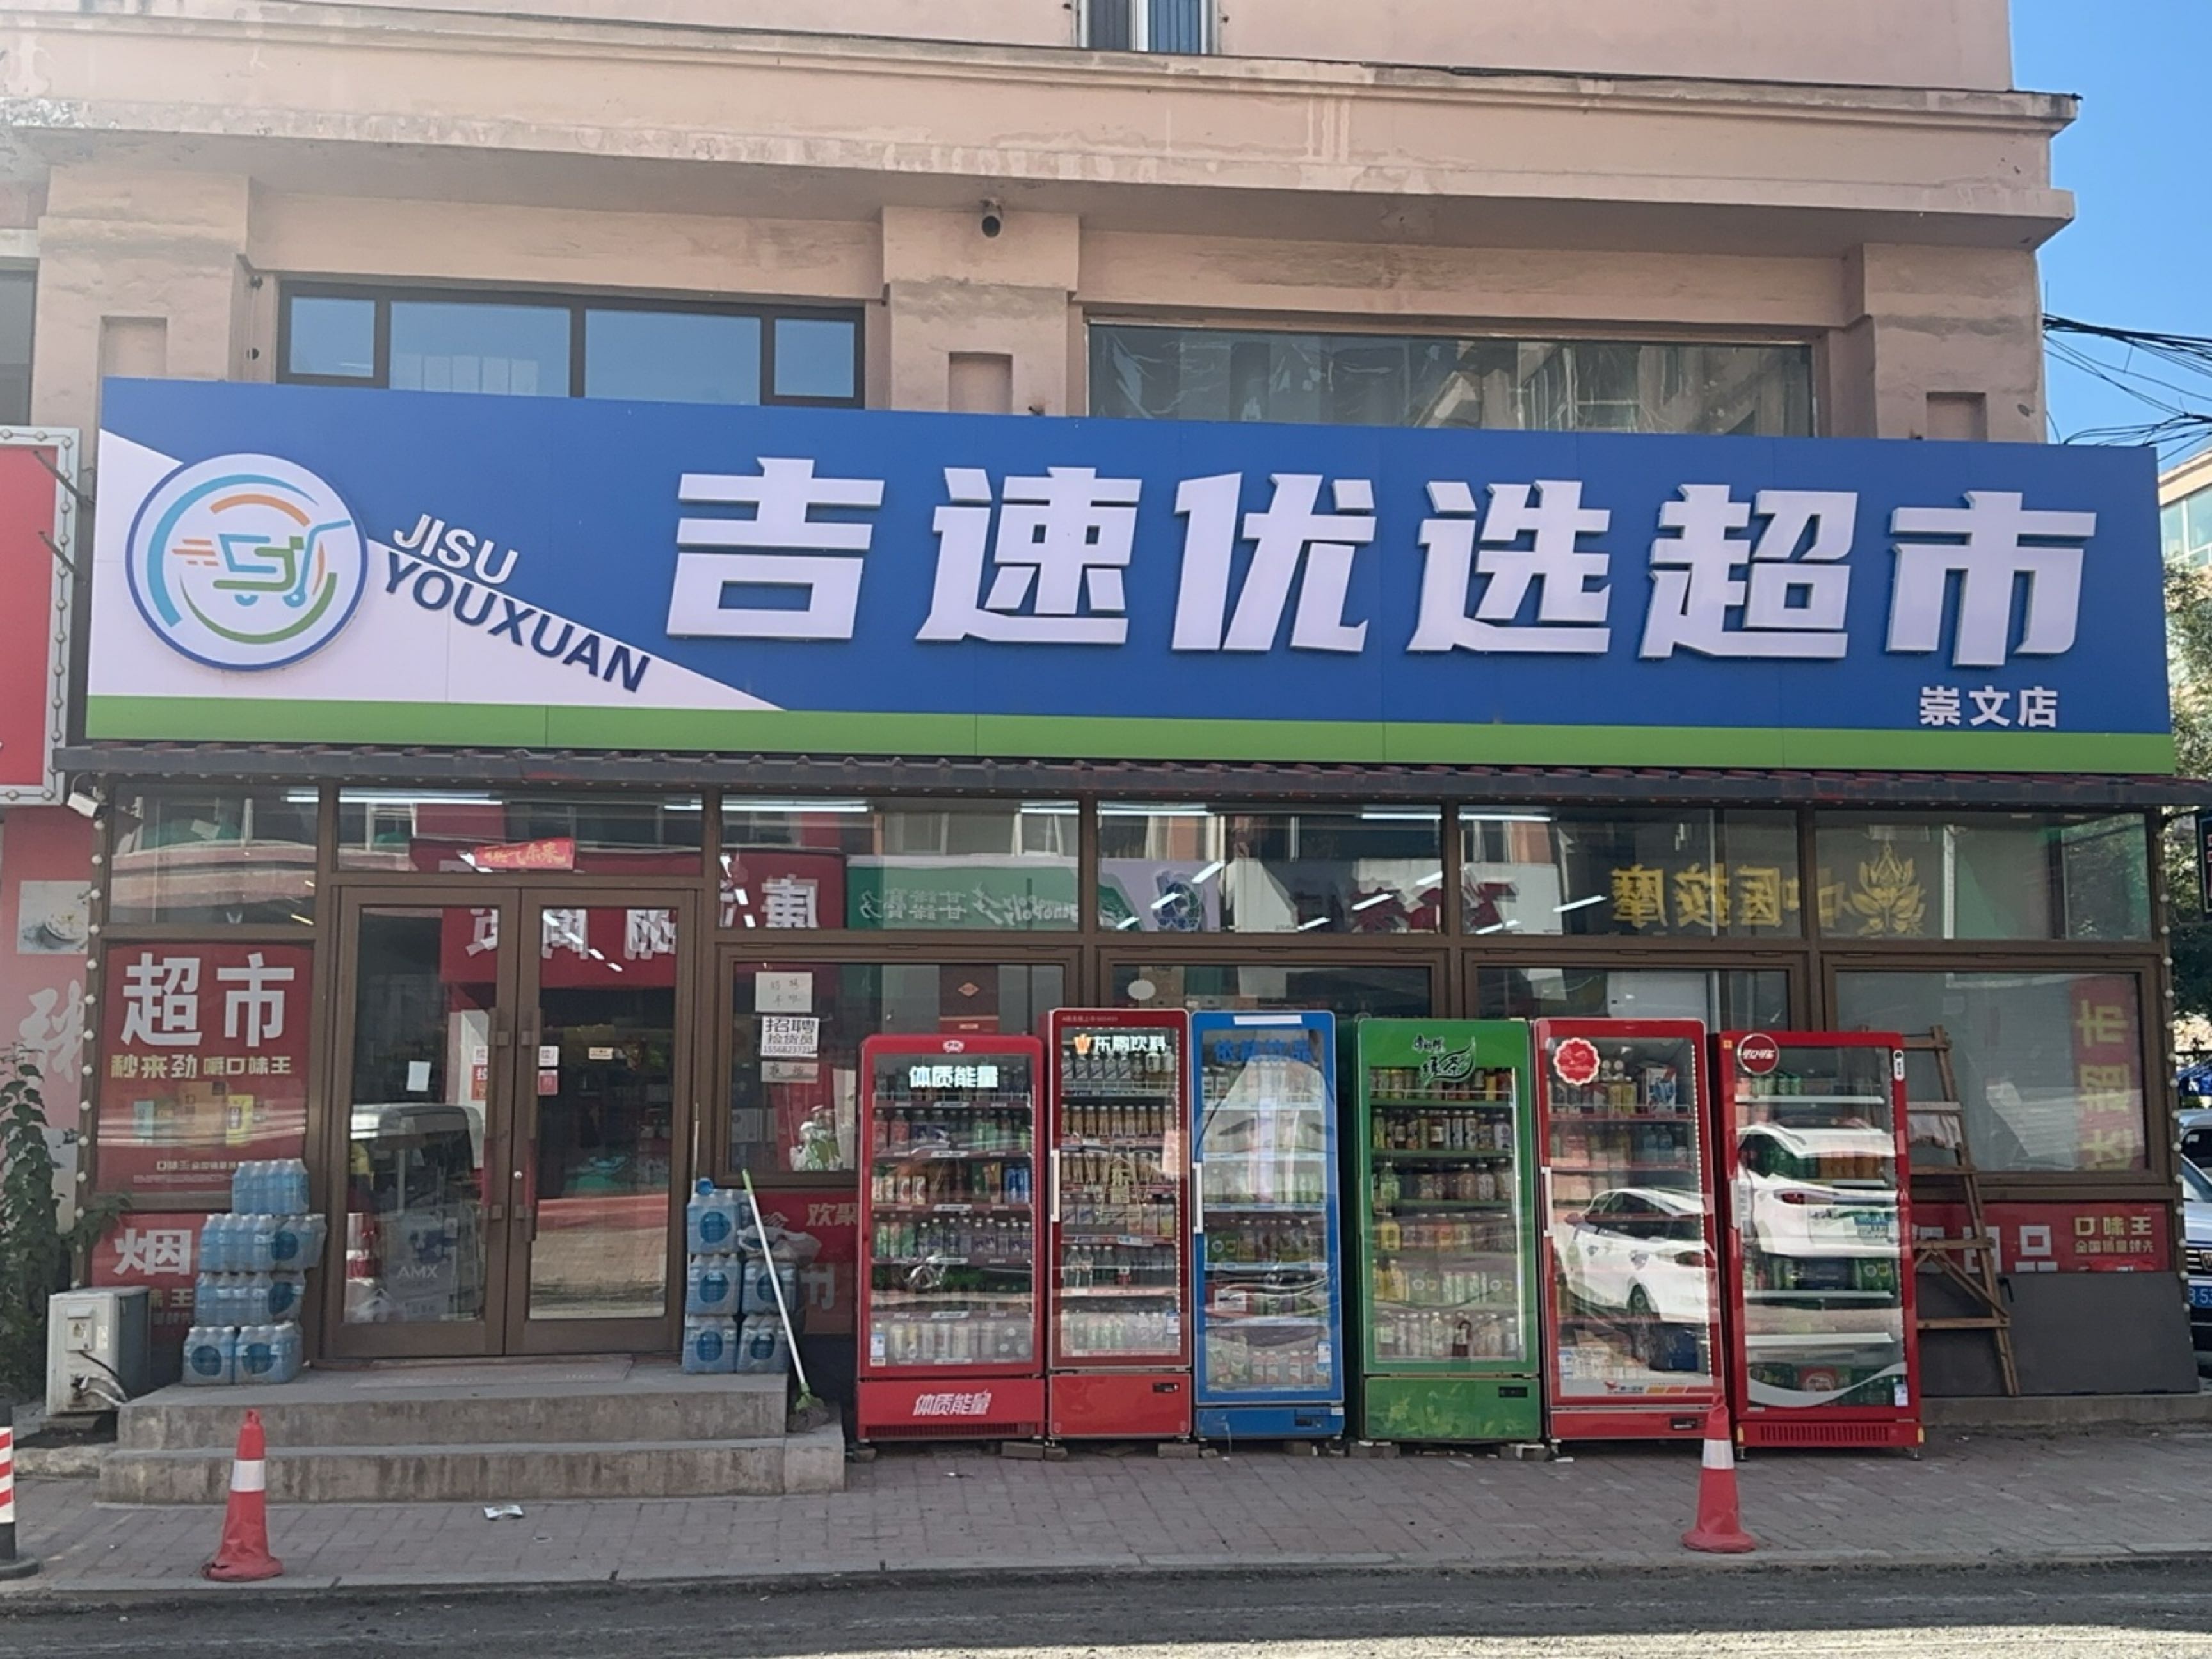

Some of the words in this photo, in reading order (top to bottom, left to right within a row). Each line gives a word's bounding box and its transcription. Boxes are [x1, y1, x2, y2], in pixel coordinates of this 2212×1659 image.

[392, 513, 518, 585] JISU
[666, 456, 2096, 668] 吉速优选超市
[383, 552, 650, 692] YOUXUAN
[1919, 686, 2059, 729] 崇文店
[120, 952, 295, 1048] 超市
[111, 1054, 198, 1080] 秒来劲
[908, 1064, 999, 1089] 体质能量
[2074, 1216, 2153, 1236] 口味王
[114, 1228, 191, 1276] 烟
[913, 1389, 991, 1416] 体质能量
